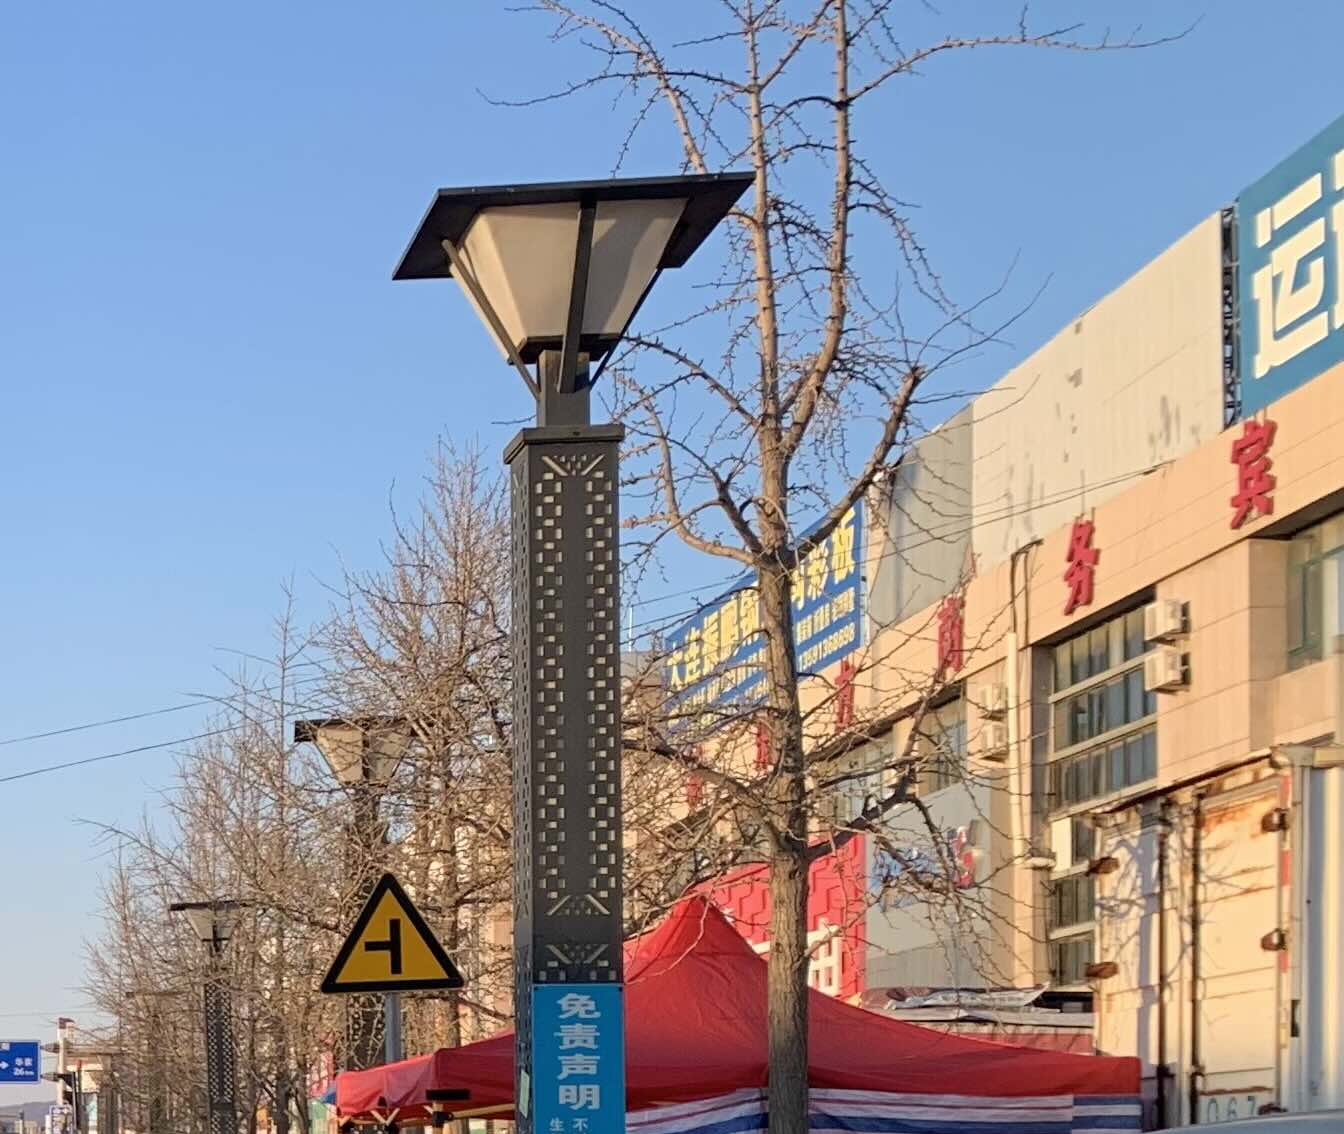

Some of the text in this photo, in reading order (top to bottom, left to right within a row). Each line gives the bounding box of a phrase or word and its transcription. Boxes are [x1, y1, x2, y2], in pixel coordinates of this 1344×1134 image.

[1253, 148, 1343, 380] 运
[554, 993, 601, 1110] 免责声明
